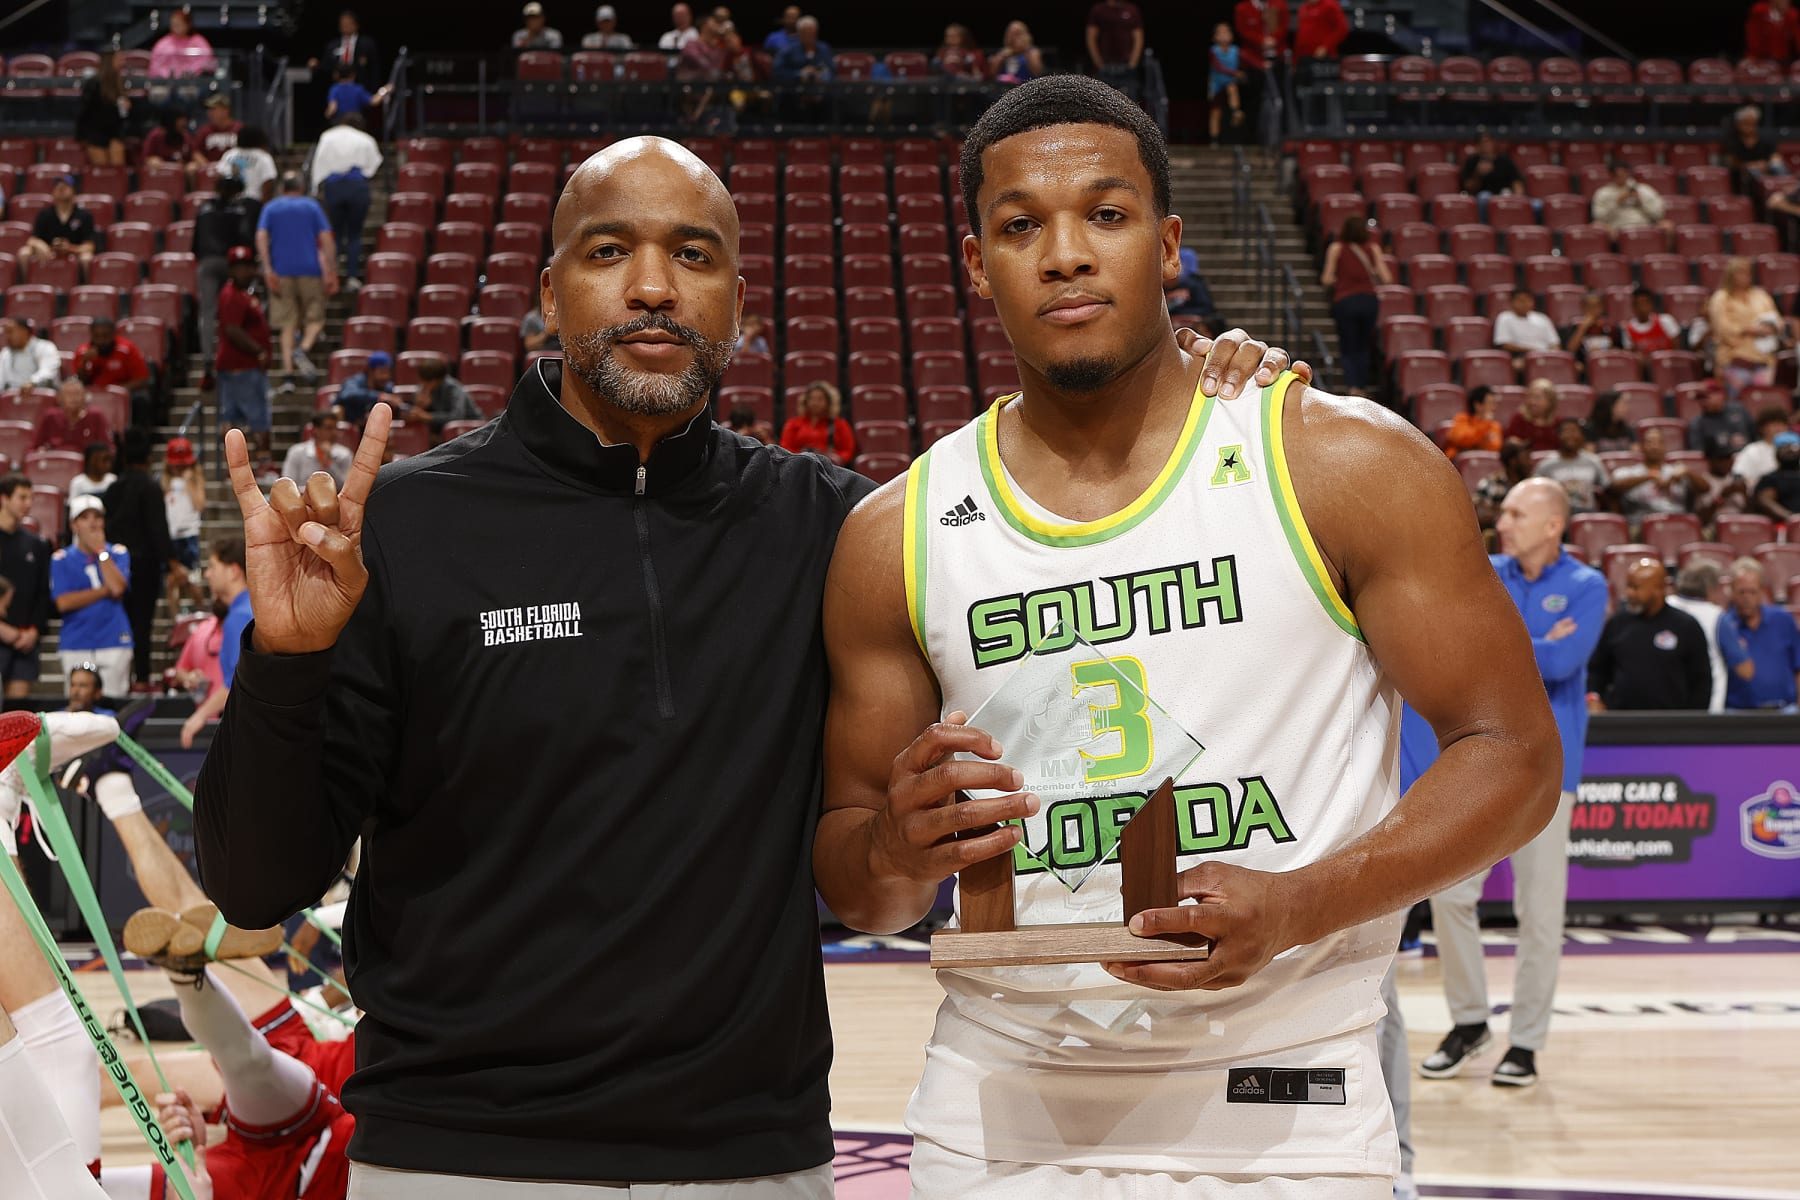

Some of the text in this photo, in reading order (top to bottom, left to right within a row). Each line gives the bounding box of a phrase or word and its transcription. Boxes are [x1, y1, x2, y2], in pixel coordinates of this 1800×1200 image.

[940, 512, 985, 526] adidas
[480, 602, 581, 630] SOUTH FLORIDA
[967, 554, 1243, 670] SOUTH
[484, 621, 584, 647] BASKETBALL
[1071, 655, 1154, 784] 3
[1040, 758, 1097, 778] MVP
[1022, 779, 1117, 792] December 9, 2023
[1577, 781, 1678, 803] YOUR CAR &
[1000, 776, 1297, 876] LORDA
[1571, 802, 1710, 829] AID TODAY!
[1565, 838, 1674, 857] oNation.com
[52, 954, 105, 1041] FITN
[1232, 1083, 1293, 1095] adidas L
[110, 1061, 175, 1165] ROGUE
